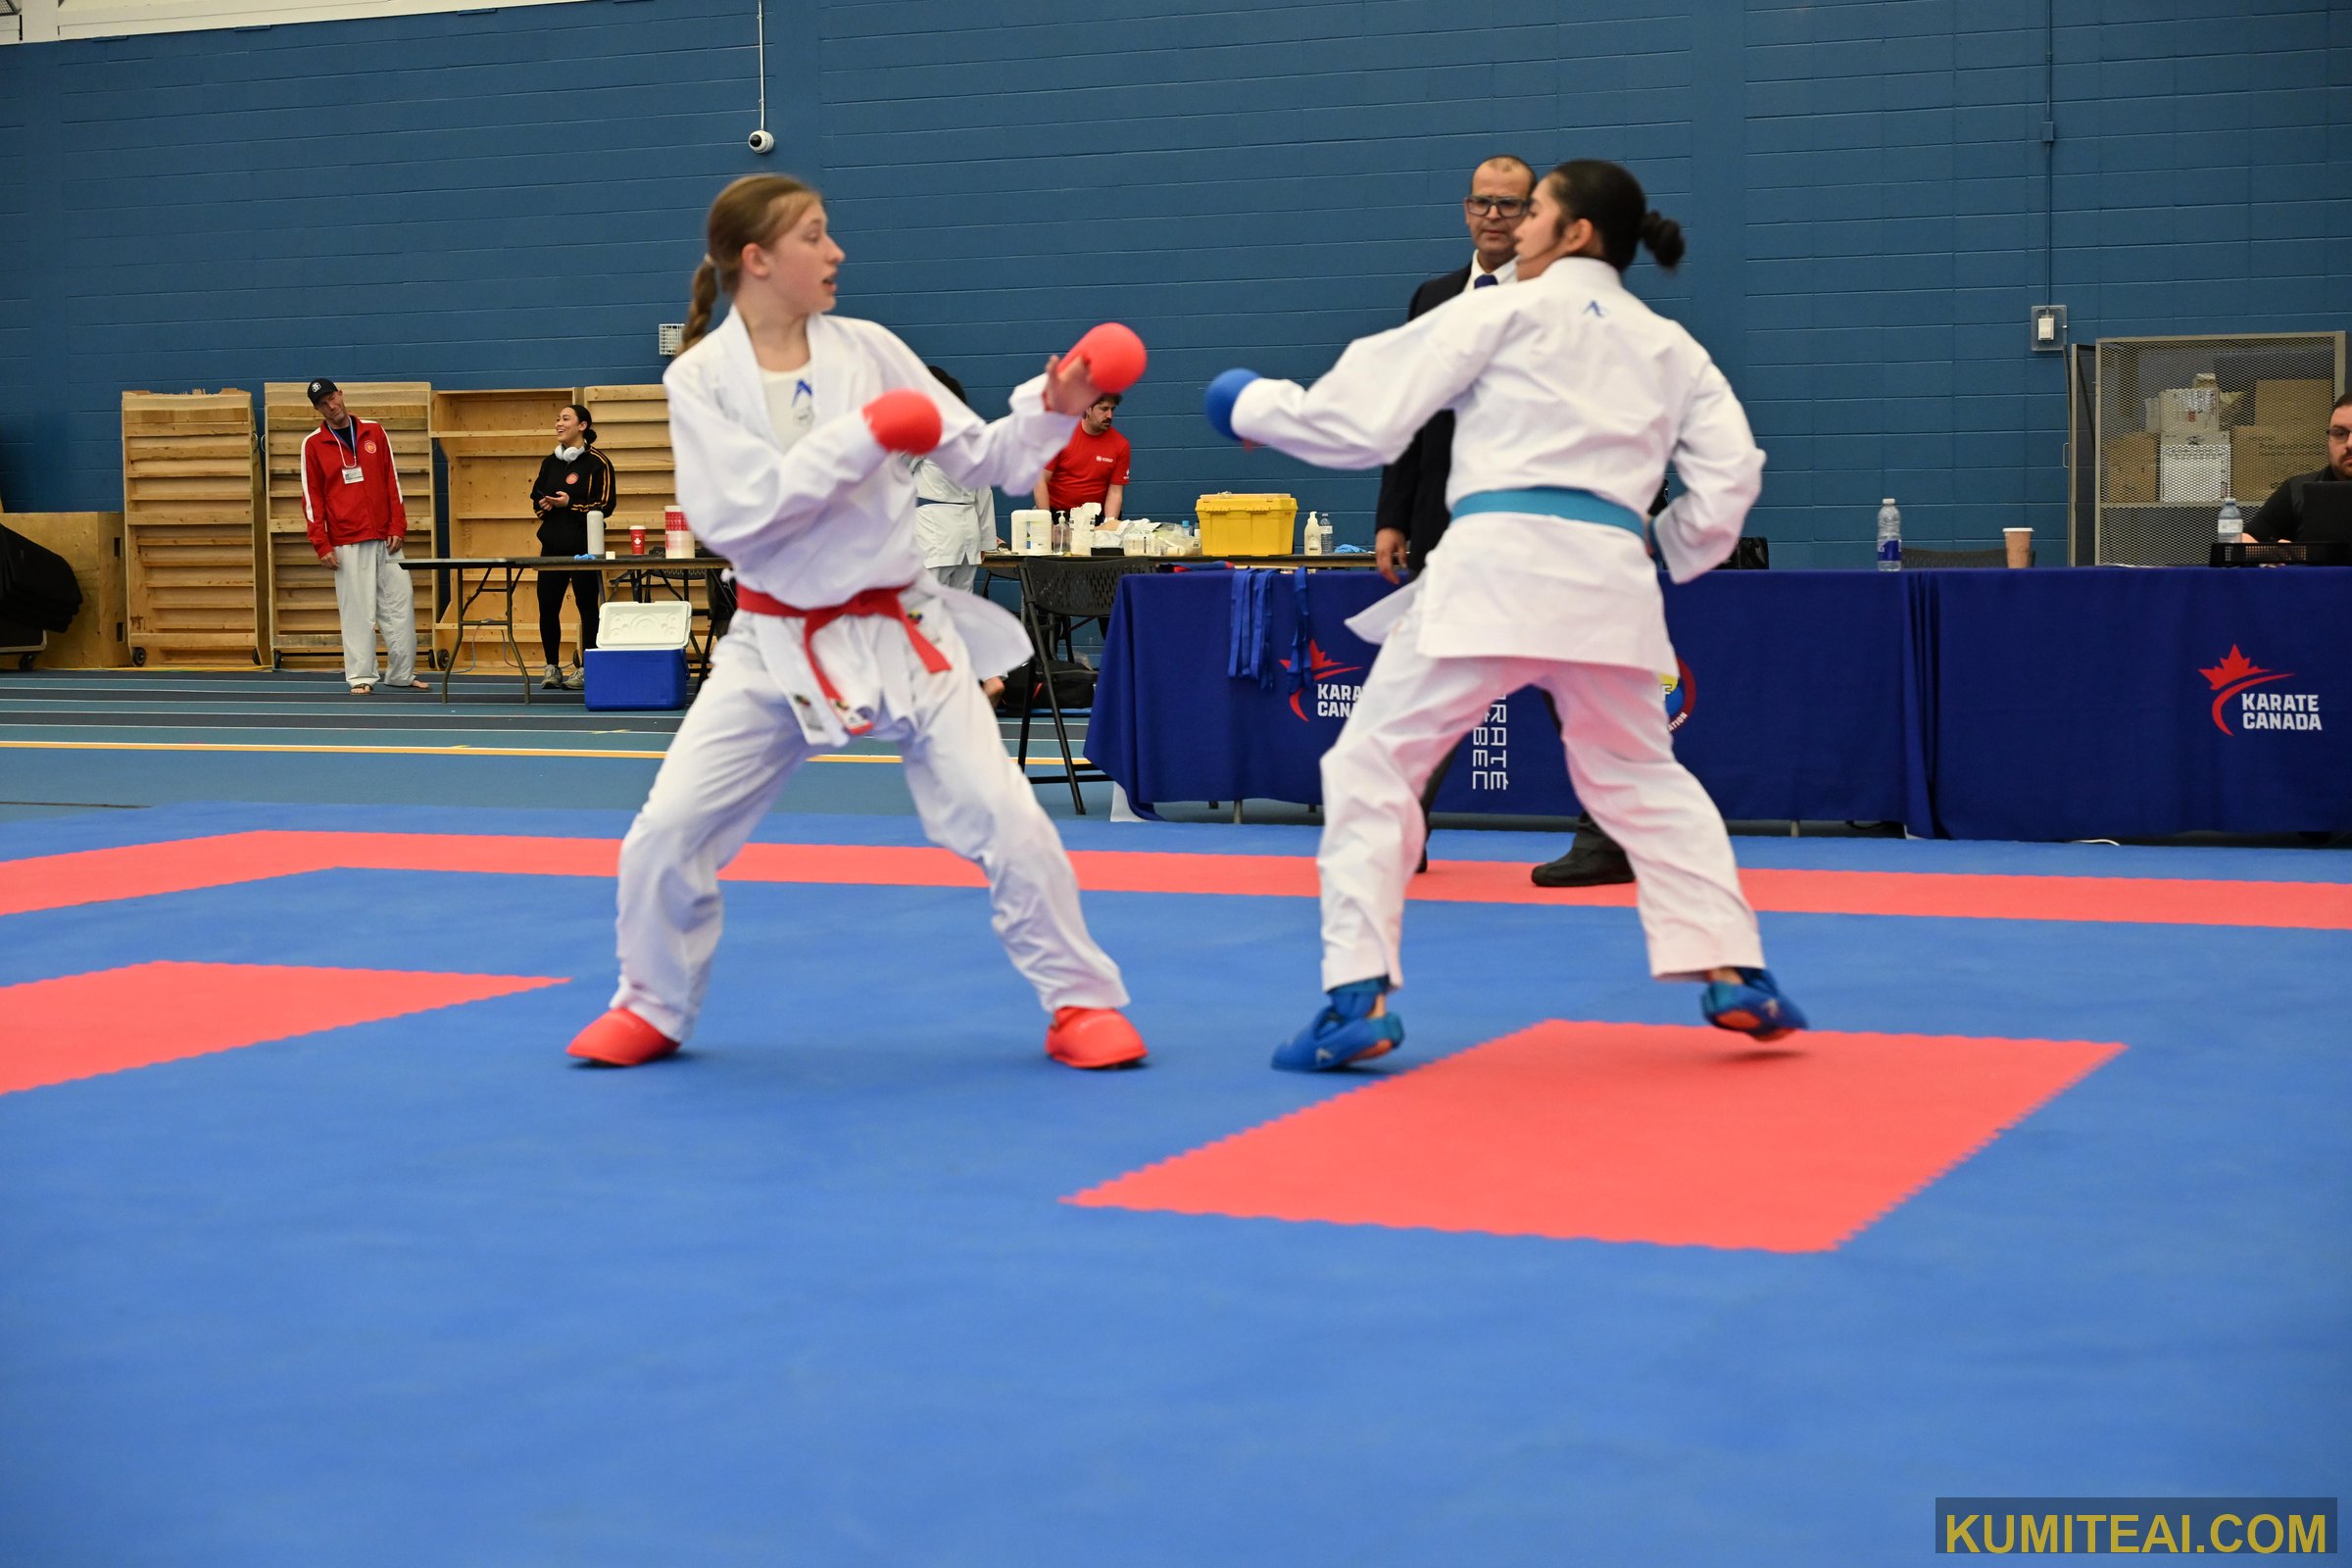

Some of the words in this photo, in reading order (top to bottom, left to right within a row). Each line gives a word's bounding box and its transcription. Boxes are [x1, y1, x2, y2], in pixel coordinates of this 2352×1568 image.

[1317, 683, 1363, 701] KARA
[1317, 701, 1351, 717] CAN
[2241, 693, 2320, 712] KARATE
[2242, 711, 2323, 731] CANADA
[1472, 712, 1489, 790] BEC
[1490, 695, 1509, 790] RATÉ
